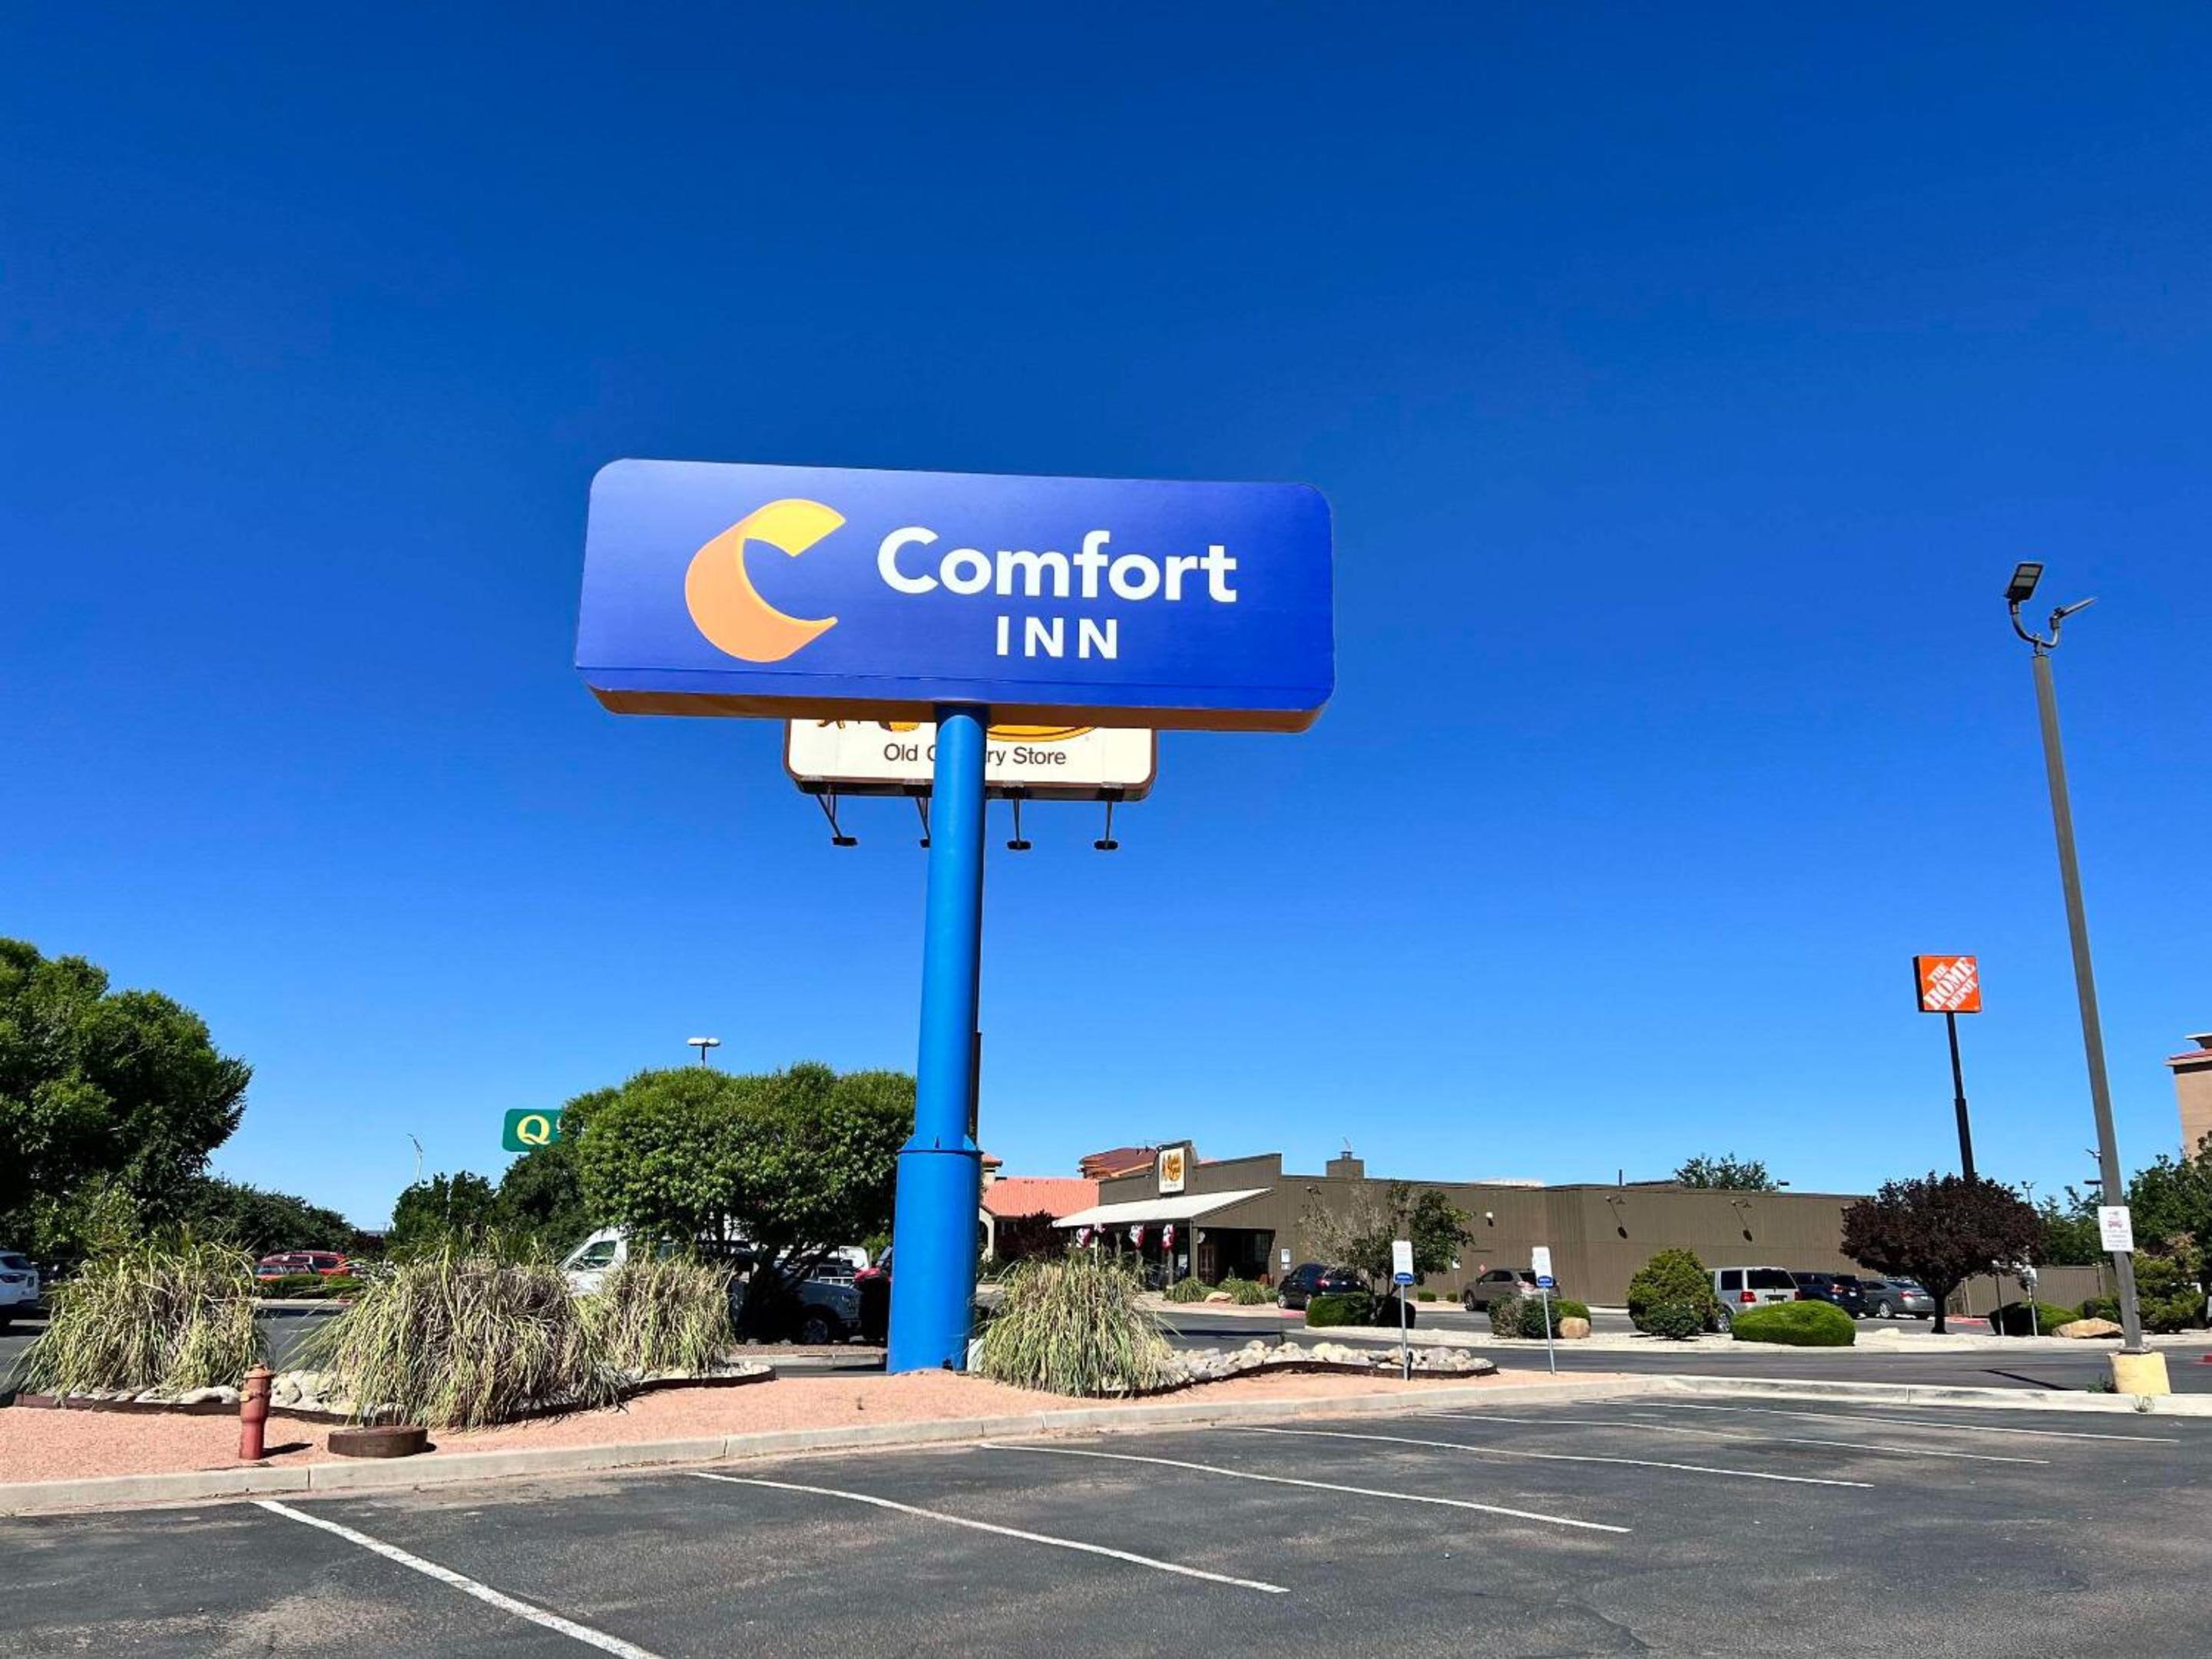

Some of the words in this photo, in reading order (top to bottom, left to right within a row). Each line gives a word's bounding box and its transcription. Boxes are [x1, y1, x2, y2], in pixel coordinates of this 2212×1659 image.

[877, 526, 1238, 603] Comfort
[996, 615, 1118, 660] INN
[883, 743, 919, 763] Old
[1012, 746, 1067, 766] Store
[1922, 957, 1976, 1010] HOME
[517, 1114, 551, 1146] Q
